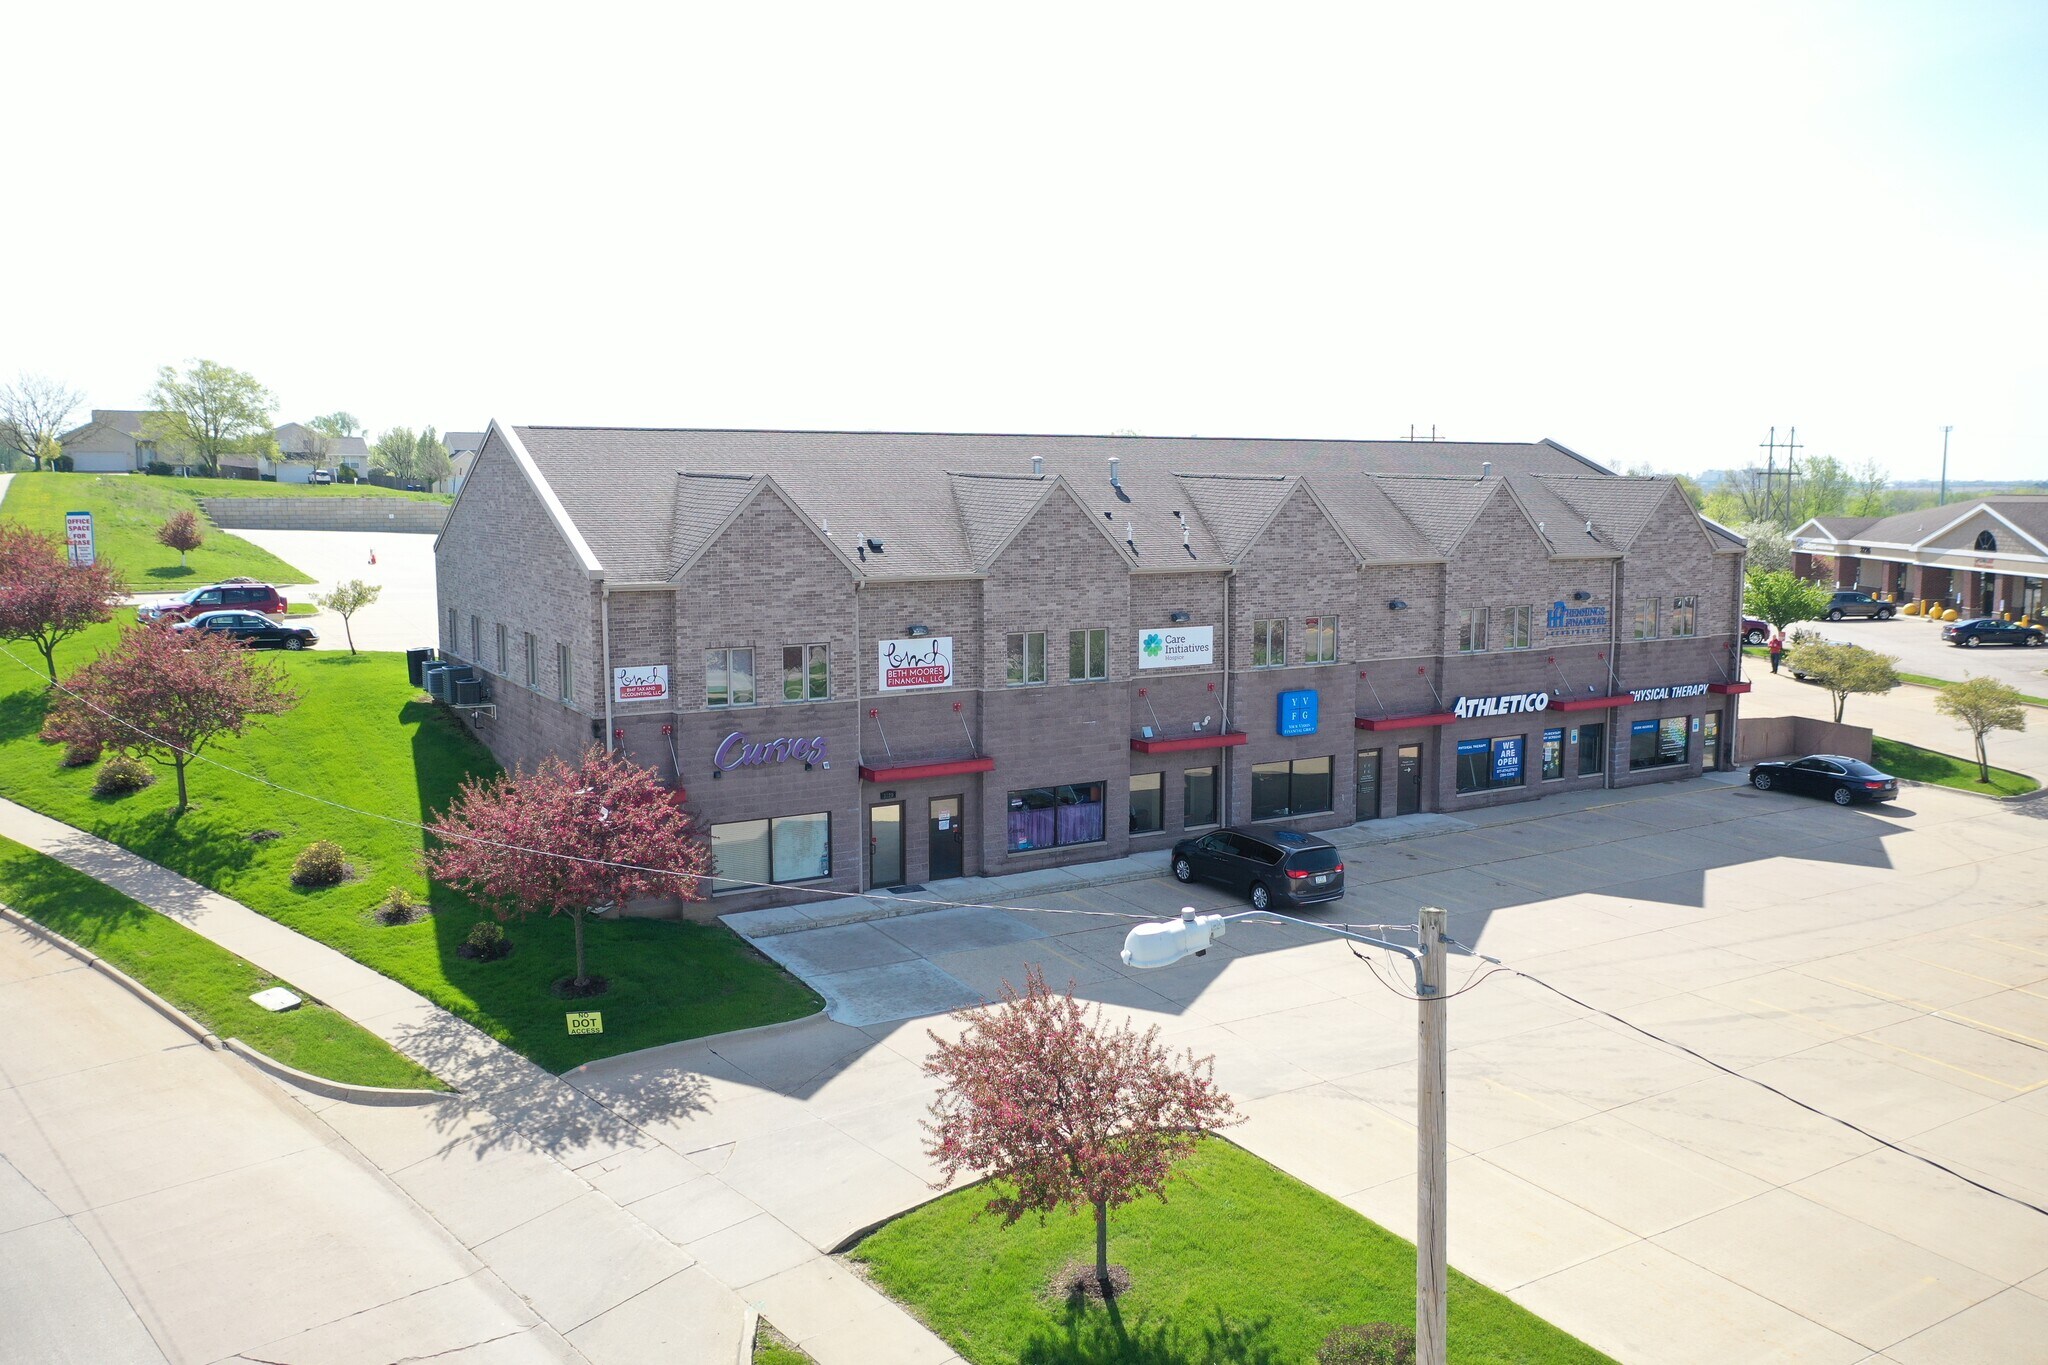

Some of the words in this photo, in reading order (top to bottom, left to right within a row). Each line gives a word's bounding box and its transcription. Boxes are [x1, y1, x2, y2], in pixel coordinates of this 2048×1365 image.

[1565, 617, 1606, 627] FINANCIAL
[1165, 635, 1186, 644] Care
[1165, 643, 1209, 654] Initiatives
[887, 669, 907, 678] BETH
[909, 667, 943, 676] MOORES
[887, 677, 929, 686] FINANCIAL,
[930, 675, 943, 683] LLC
[1671, 683, 1709, 698] THERAPY
[1292, 698, 1297, 706] Y
[1454, 692, 1548, 718] ATHLETICO
[1302, 711, 1308, 719] G
[1503, 741, 1514, 749] WE
[714, 731, 828, 771] Curves
[1501, 749, 1515, 758] ARE
[1497, 757, 1518, 766] OPEN
[572, 1018, 597, 1028] DOT
